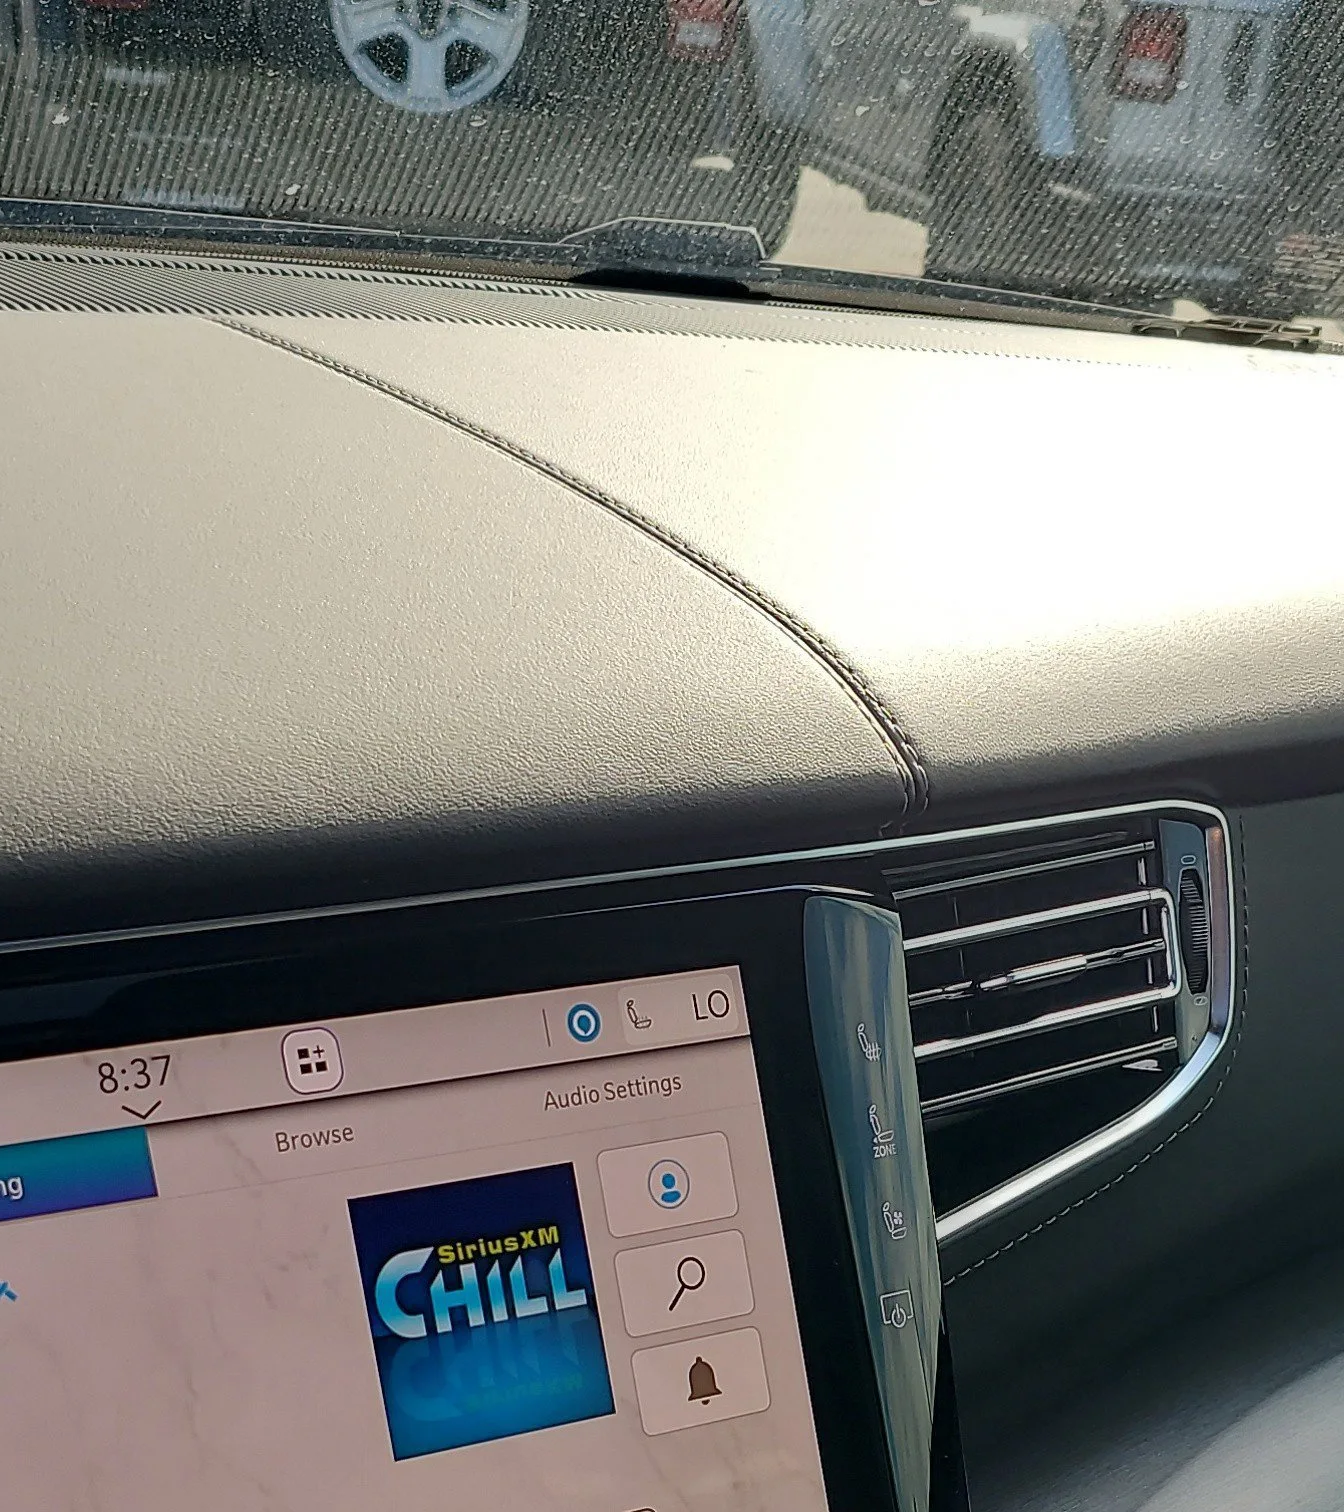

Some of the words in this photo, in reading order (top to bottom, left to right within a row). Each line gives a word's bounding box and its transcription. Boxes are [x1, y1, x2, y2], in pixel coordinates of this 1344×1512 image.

[692, 988, 732, 1023] LO
[98, 1055, 172, 1096] 8:37
[544, 1080, 598, 1112] Audio
[602, 1072, 683, 1107] Settings
[275, 1121, 355, 1154] Browse
[872, 1142, 898, 1158] ZONE
[437, 1225, 560, 1264] SiriusXM
[375, 1247, 588, 1339] CHILL
